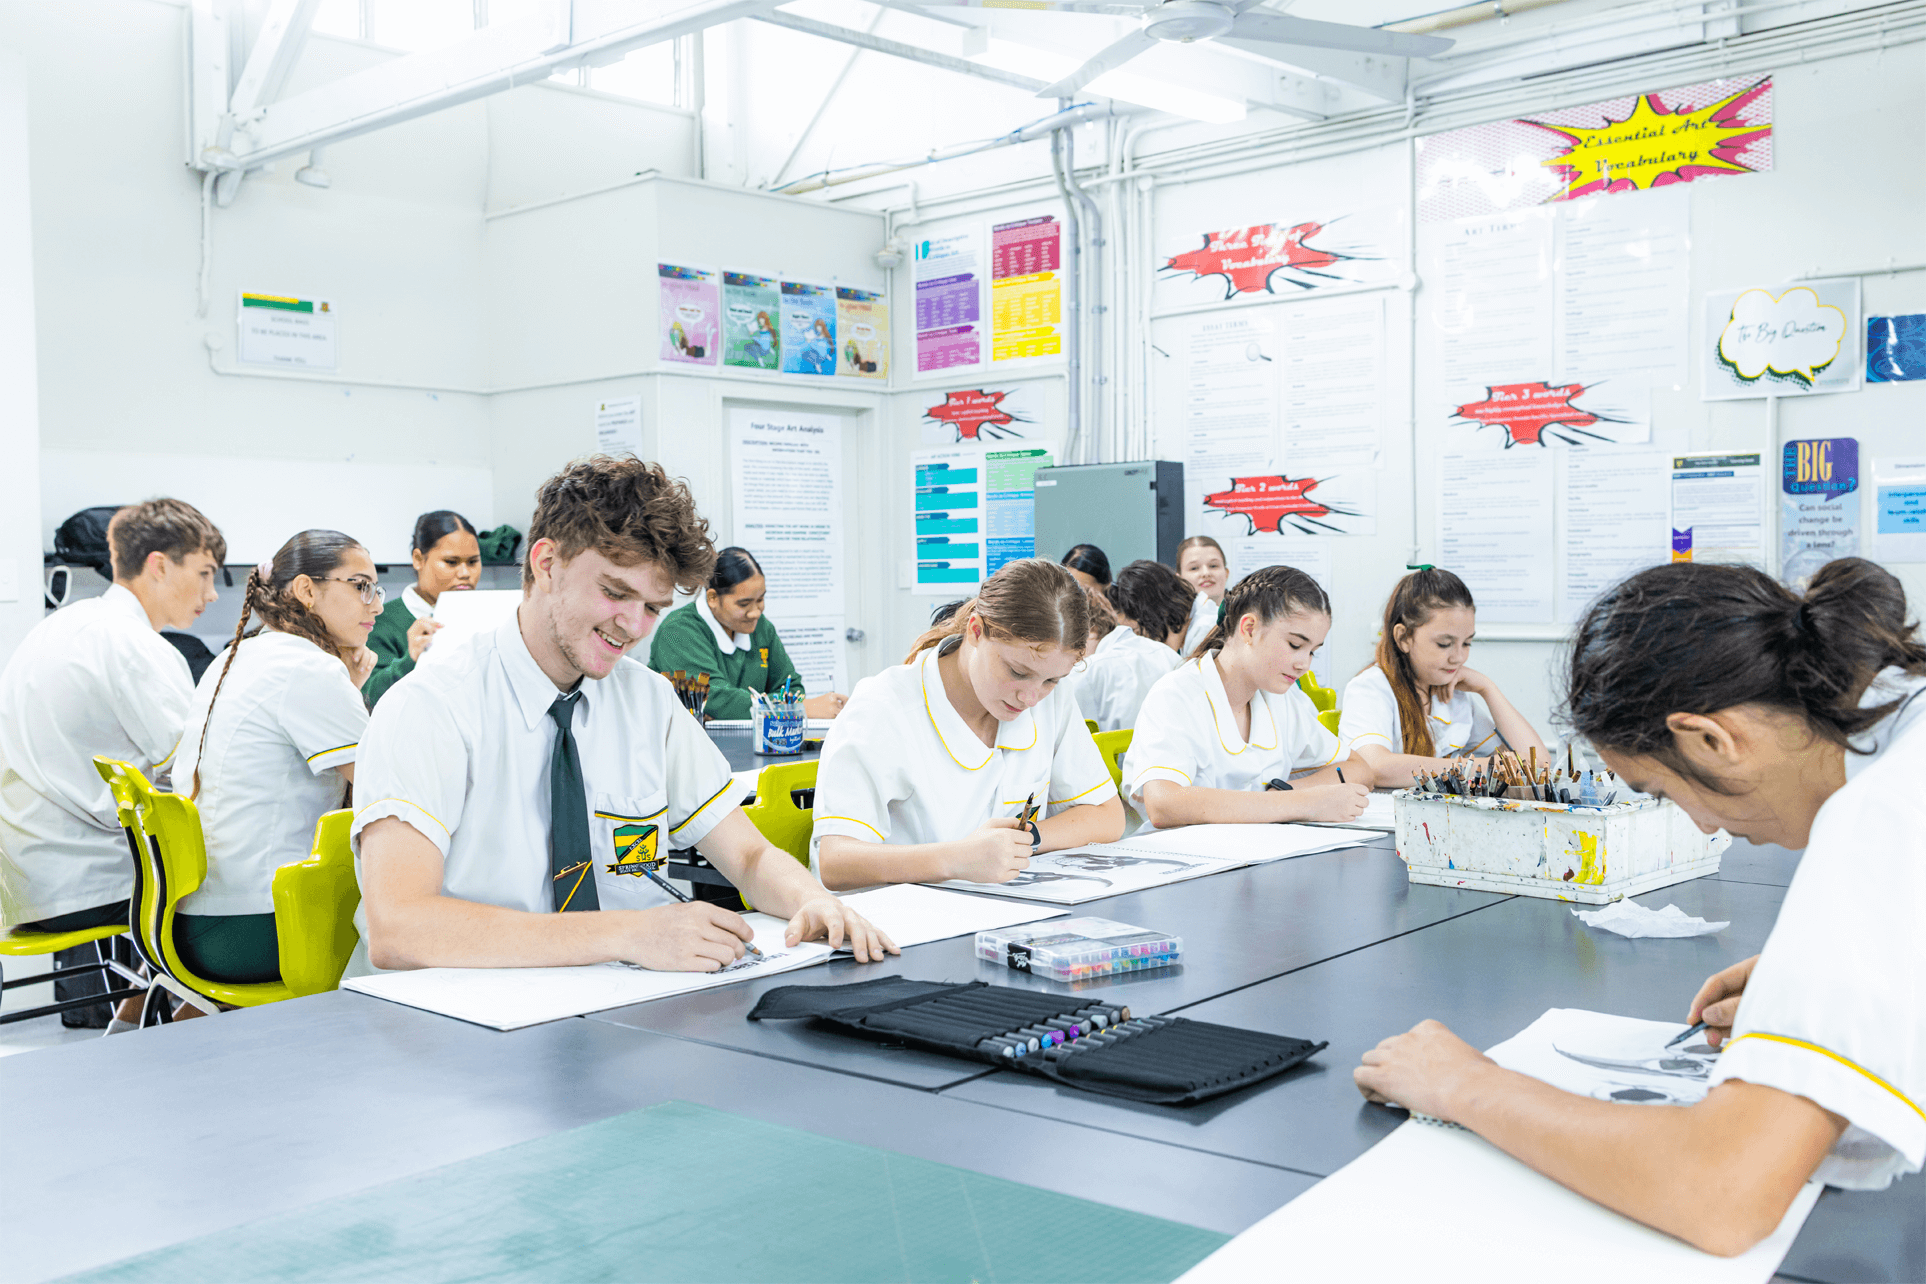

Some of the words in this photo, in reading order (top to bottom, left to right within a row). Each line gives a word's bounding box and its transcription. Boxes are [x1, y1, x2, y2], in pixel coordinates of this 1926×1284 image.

[1584, 125, 1665, 148] Essential
[1671, 119, 1710, 135] Art
[1595, 150, 1699, 172] Vocabulary
[1755, 322, 1777, 344] Big
[1781, 320, 1827, 339] Question
[972, 395, 995, 405] words
[1492, 390, 1518, 402] Tier
[1522, 388, 1530, 400] 3
[1533, 387, 1571, 399] words
[751, 422, 765, 430] Four
[766, 423, 785, 433] Stage
[786, 424, 798, 432] Art
[799, 425, 824, 435] Analysis
[1784, 446, 1797, 478] THE
[1797, 440, 1833, 482] BIG
[1234, 483, 1256, 493] Tier
[1259, 482, 1266, 492] 2
[1268, 482, 1299, 492] words
[1798, 503, 1816, 512] Can
[1817, 503, 1843, 511] social
[1798, 516, 1830, 525] change
[1787, 529, 1816, 537] driven
[1818, 527, 1853, 537] through
[1813, 540, 1835, 548] lens?
[768, 725, 784, 738] Bulk
[629, 837, 643, 851] EXCEL
